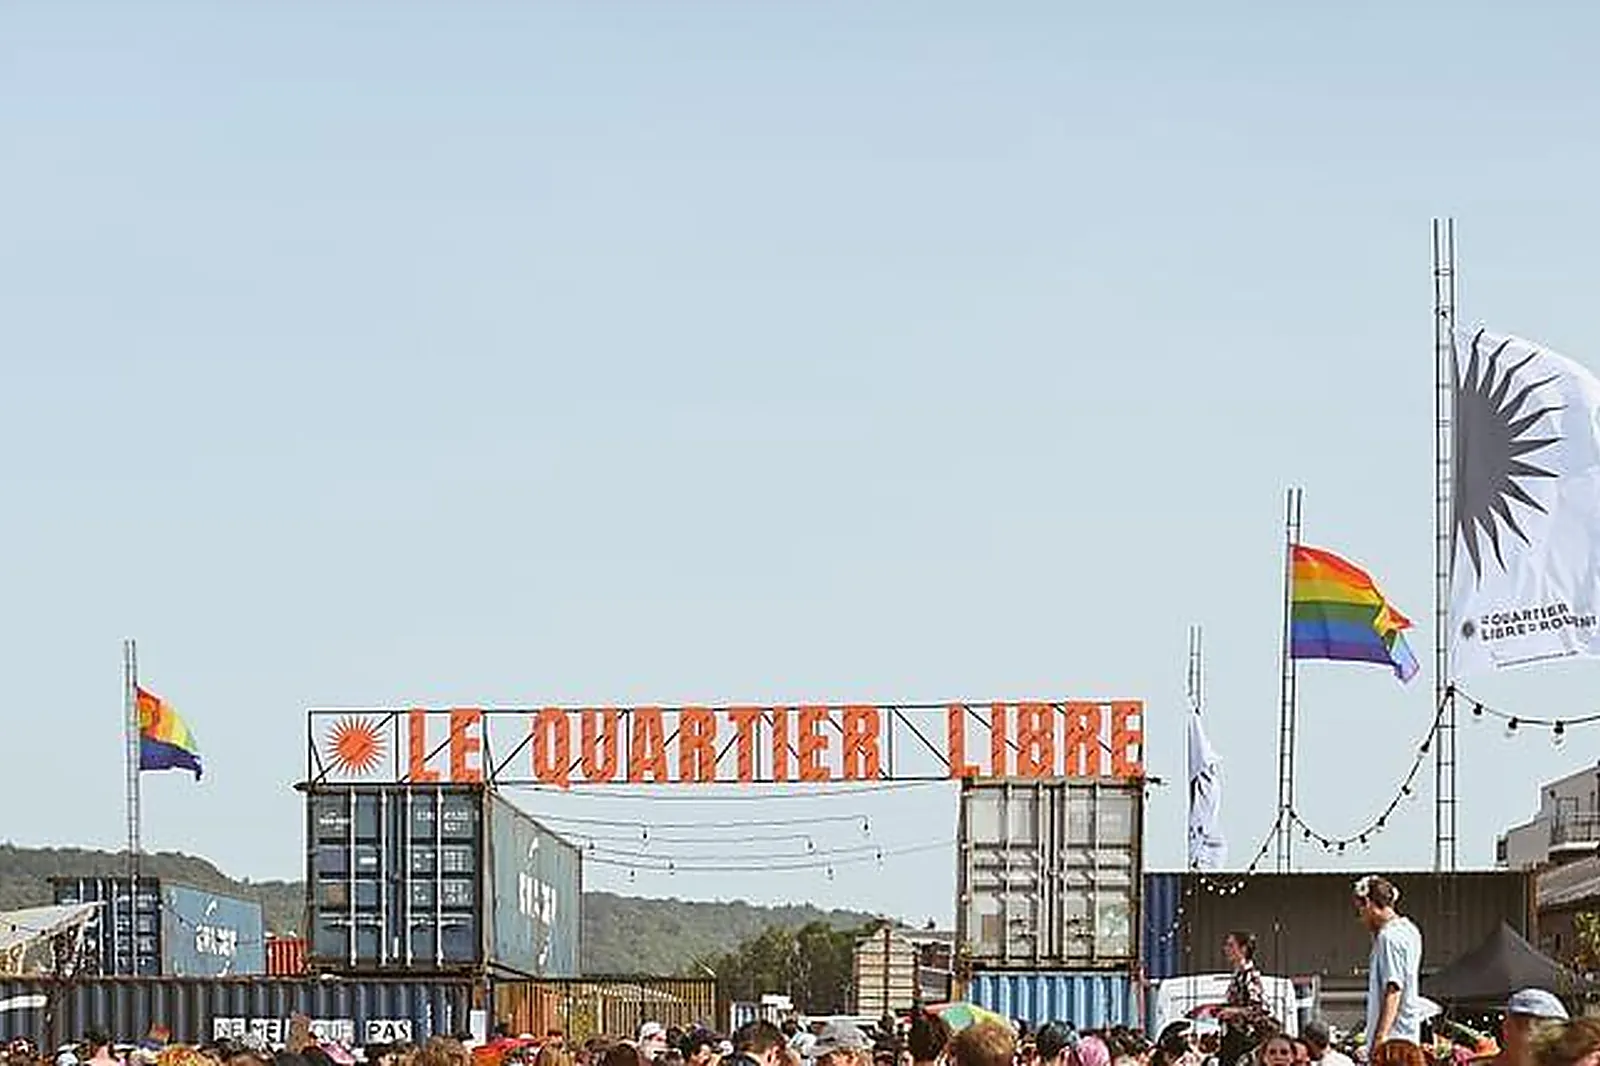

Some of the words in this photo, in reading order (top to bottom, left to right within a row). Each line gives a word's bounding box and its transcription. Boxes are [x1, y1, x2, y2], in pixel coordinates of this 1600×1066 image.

[409, 707, 482, 784] LE
[532, 704, 880, 788] QUARTIER
[948, 699, 1144, 780] LIBRE
[368, 1022, 410, 1040] PAS
